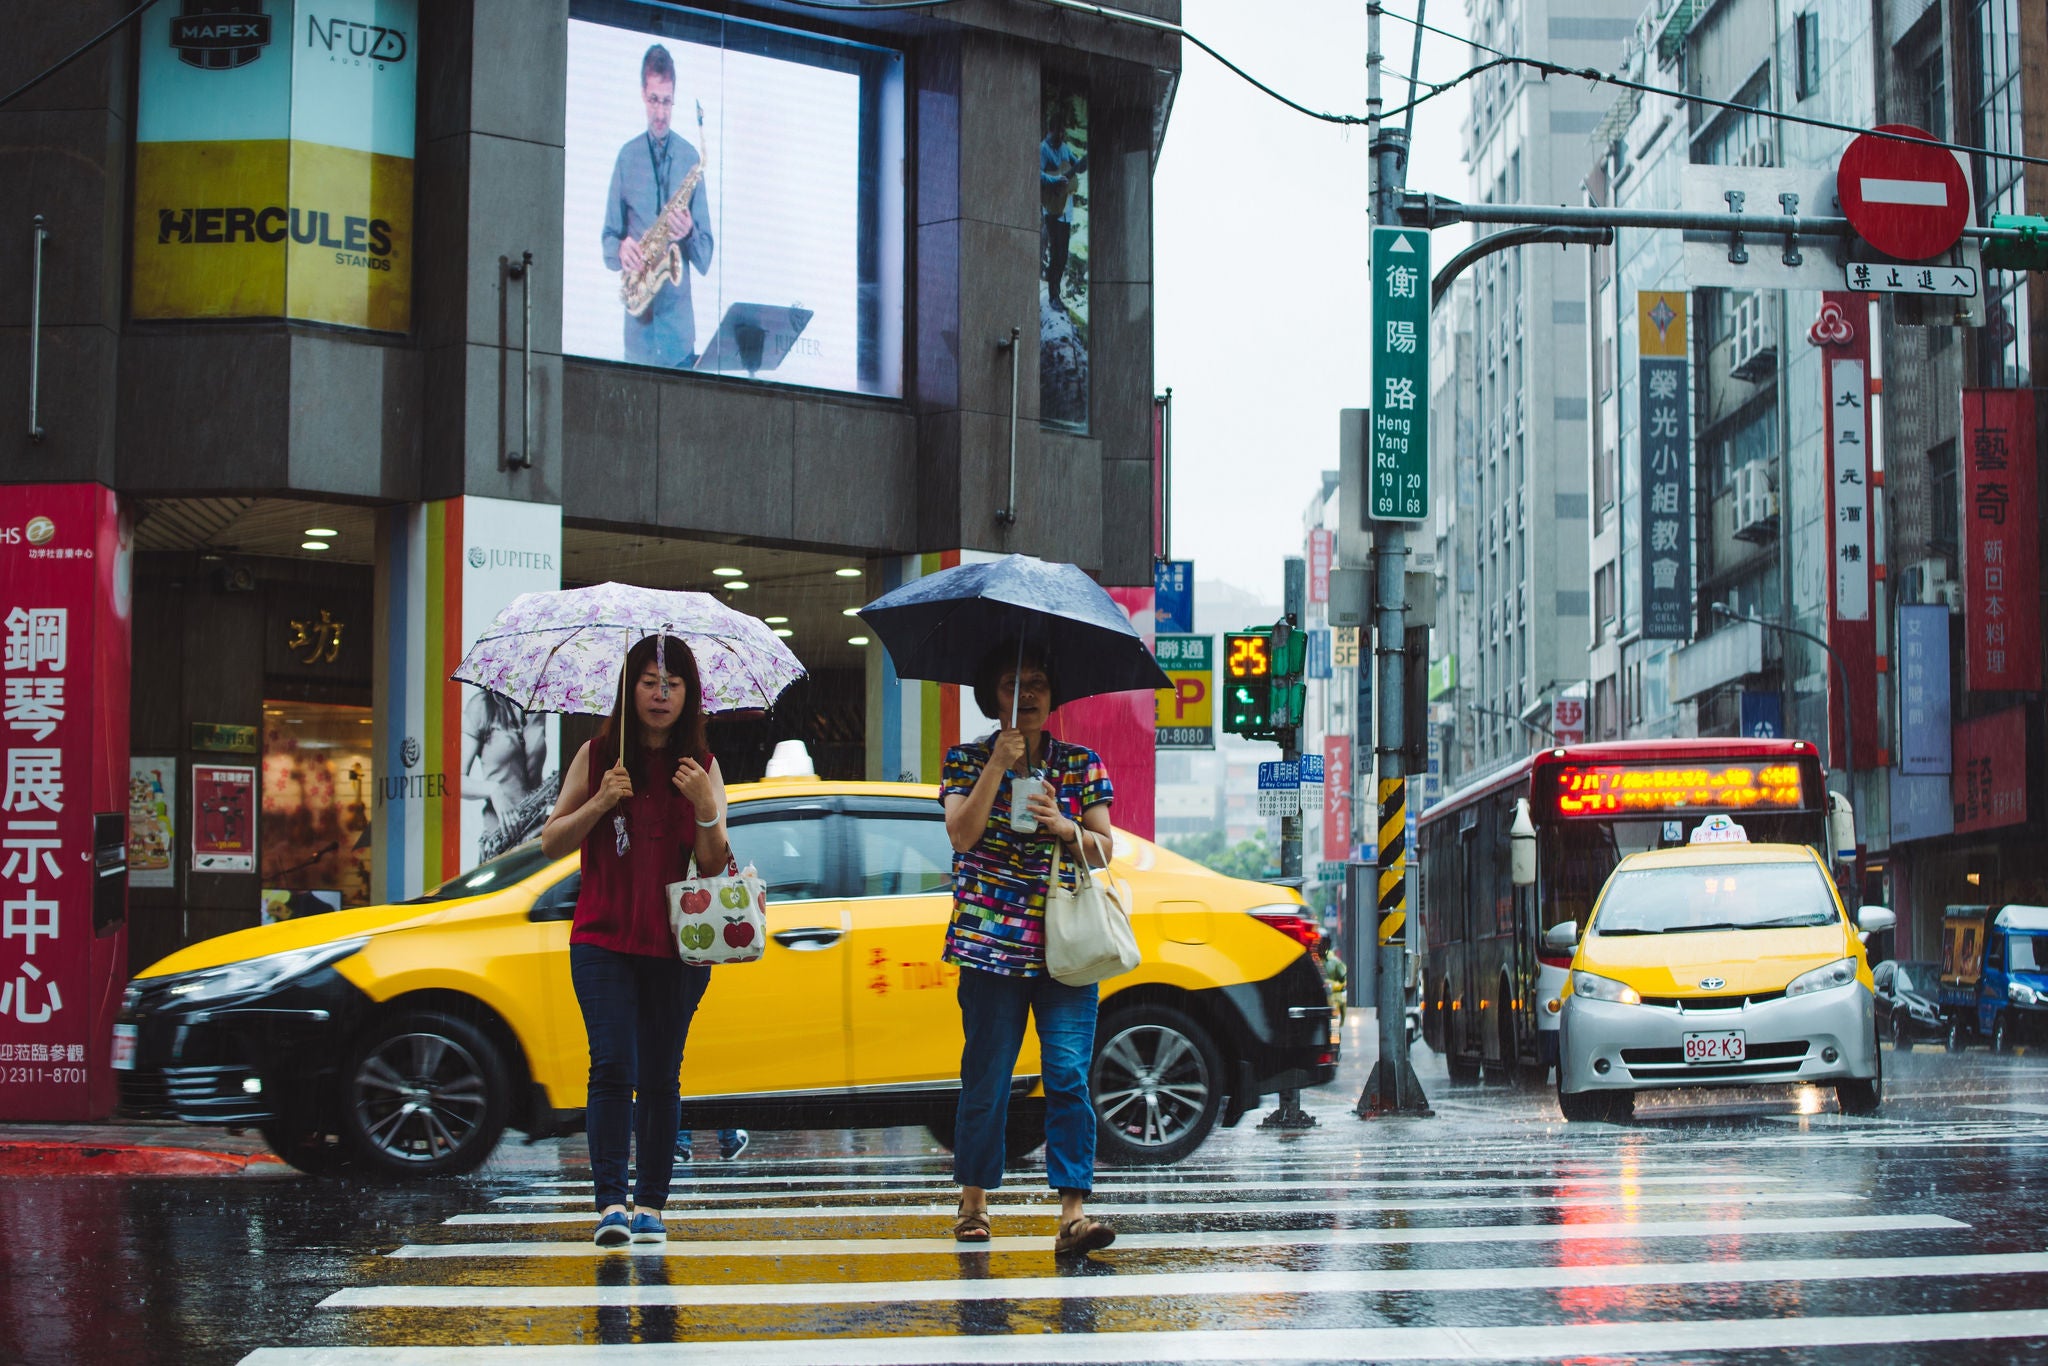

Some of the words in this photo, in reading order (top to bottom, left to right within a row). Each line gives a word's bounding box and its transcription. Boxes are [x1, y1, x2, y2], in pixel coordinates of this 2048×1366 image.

[181, 23, 260, 40] MAPEX
[329, 56, 385, 72] AUDIO
[158, 206, 392, 257] HERCULES
[335, 252, 391, 272] STANDS
[1852, 264, 1970, 291] 禁止進入
[775, 333, 825, 359] JUPITER
[1385, 264, 1419, 411] 衡陽路
[1377, 414, 1410, 434] Heng
[1378, 433, 1408, 453] Yang
[1377, 453, 1400, 470] Rd.
[1379, 472, 1393, 487] 19
[1407, 474, 1421, 489] 20
[1650, 369, 1680, 590] 榮光小組教會
[1836, 391, 1863, 563] 大三元酒樓
[1379, 498, 1393, 513] 69
[1406, 498, 1421, 514] 68
[489, 548, 554, 571] JUPITER
[1651, 602, 1680, 611] GLORY
[1983, 540, 2006, 674] 新日本料理
[1648, 623, 1685, 633] CHURCH
[1229, 637, 1268, 677] 25
[1334, 646, 1358, 665] 5F
[1174, 678, 1206, 720] P
[378, 773, 450, 808] JUPITER
[1330, 746, 1345, 814] TASTY
[0, 606, 68, 1024] 鋼琴展示中心
